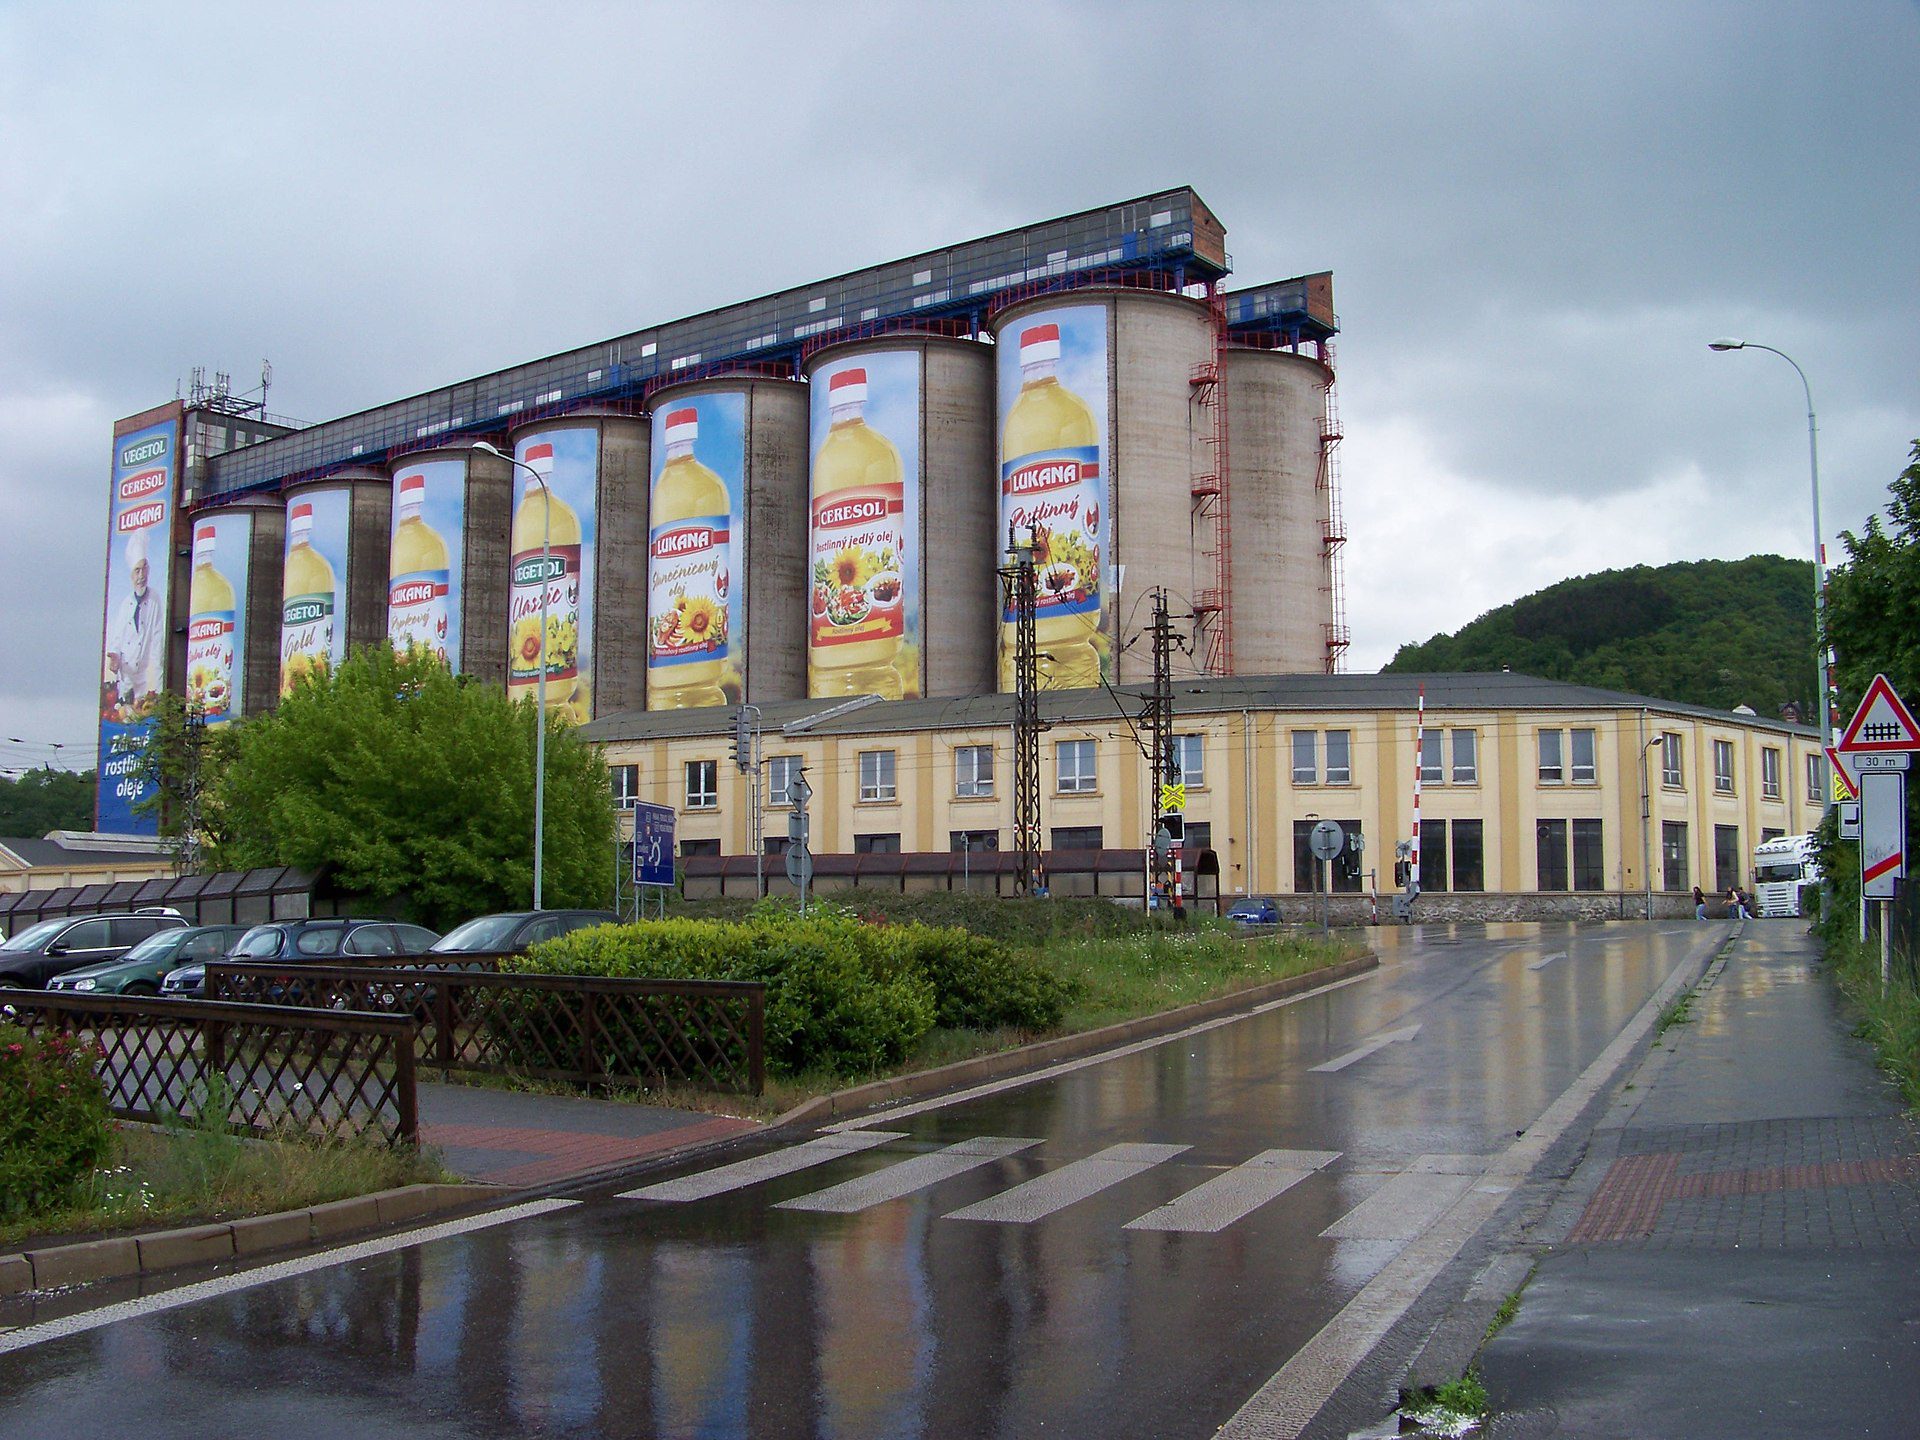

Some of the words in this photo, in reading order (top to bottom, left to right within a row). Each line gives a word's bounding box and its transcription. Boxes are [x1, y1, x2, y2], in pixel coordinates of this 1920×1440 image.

[124, 440, 165, 464] VEGETOL
[122, 474, 164, 496] CERESOL
[1013, 464, 1076, 491] LUKANA
[121, 505, 162, 530] LUKANA
[820, 501, 884, 526] CERESOL
[656, 530, 710, 555] LUKANA
[848, 531, 874, 549] jedlý
[876, 530, 894, 543] olej
[391, 584, 432, 604] LUKANA
[284, 604, 323, 623] EGETOL
[284, 626, 316, 662] Gold
[1866, 757, 1879, 766] 30
[116, 778, 144, 800] oleje
